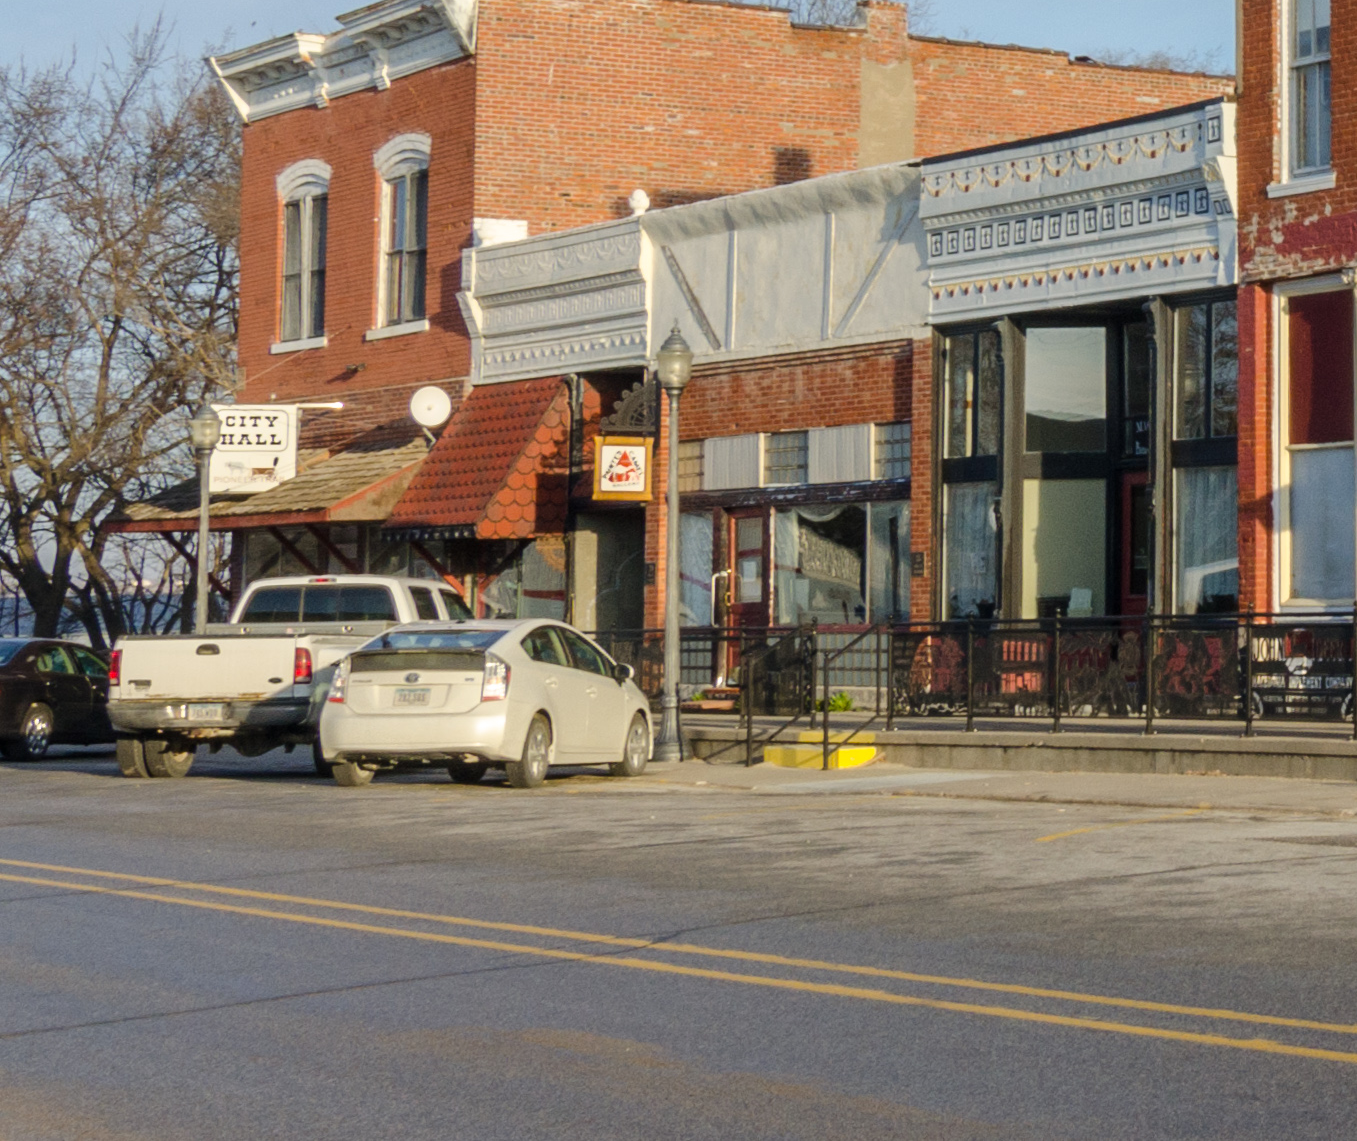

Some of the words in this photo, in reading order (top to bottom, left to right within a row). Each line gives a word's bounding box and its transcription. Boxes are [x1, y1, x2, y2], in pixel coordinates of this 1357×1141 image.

[225, 415, 279, 428] CITY
[220, 433, 282, 446] HALL
[1251, 637, 1287, 661] JOHN
